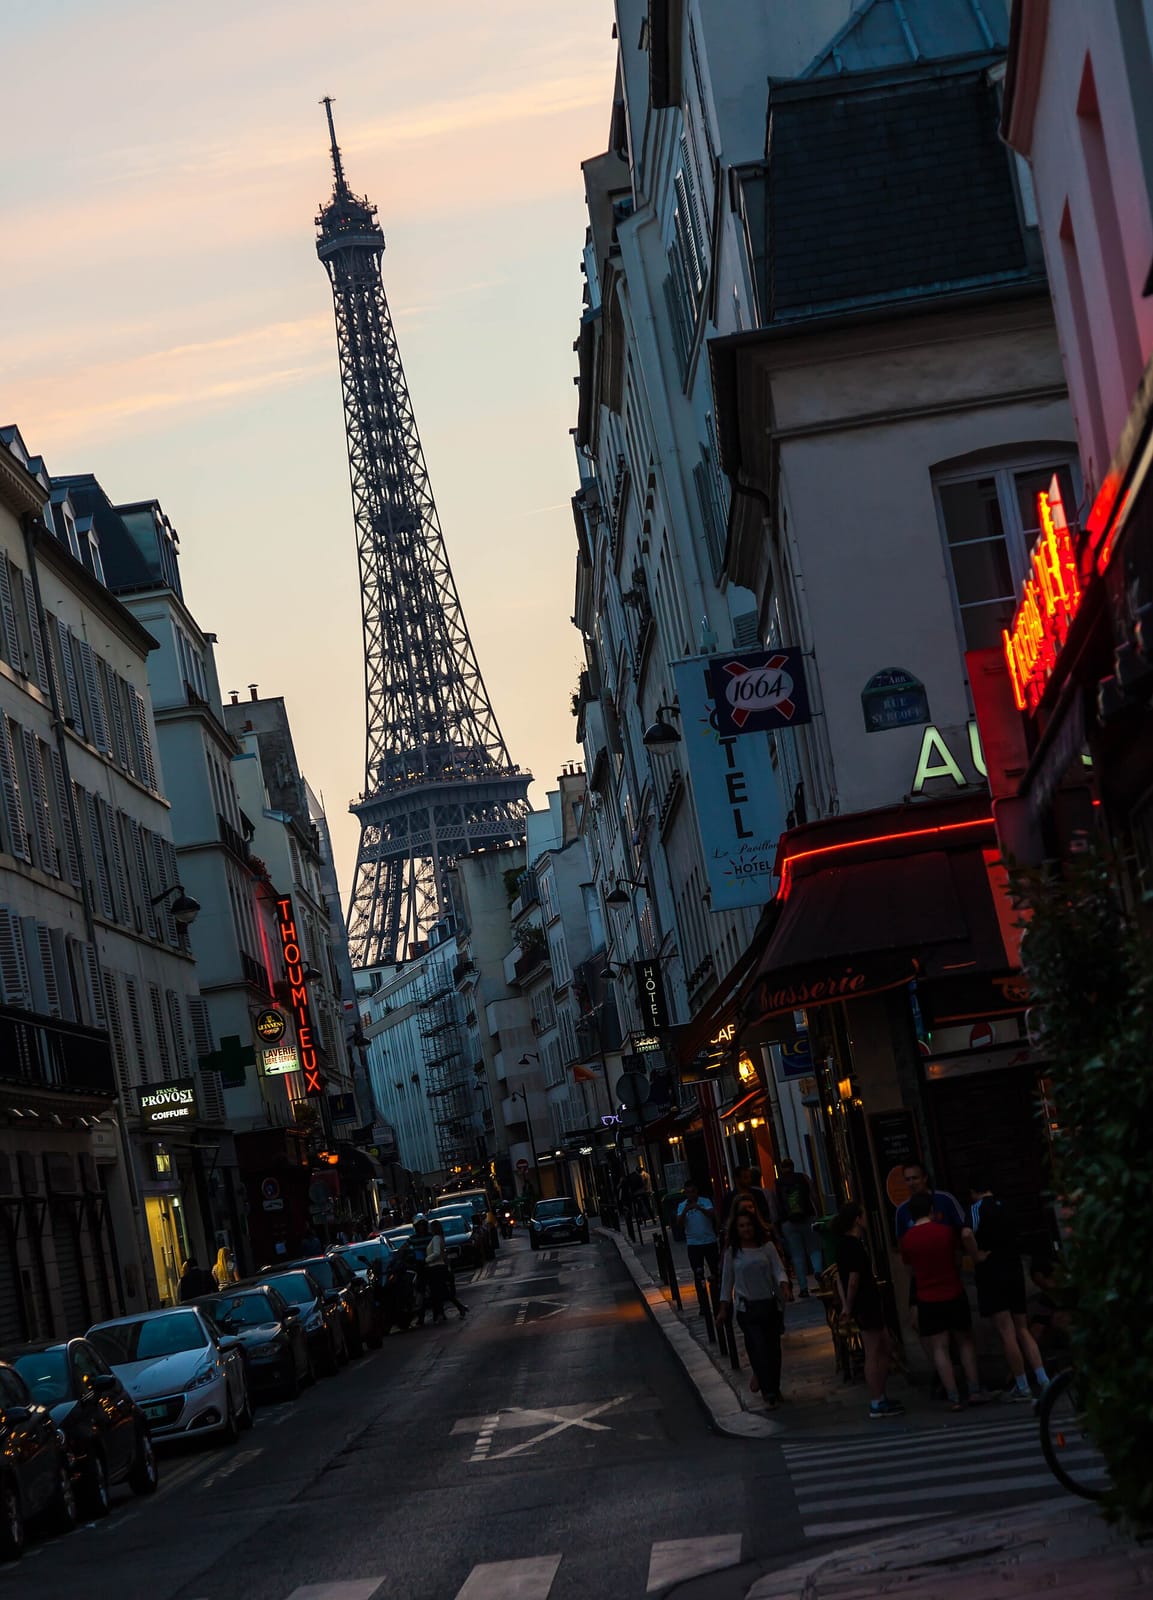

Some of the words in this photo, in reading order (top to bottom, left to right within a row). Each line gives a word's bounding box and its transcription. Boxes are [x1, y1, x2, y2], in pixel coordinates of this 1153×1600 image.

[733, 671, 787, 702] 1664
[734, 860, 772, 875] HOTEL
[276, 899, 321, 1092] THOUMIEUX
[263, 1046, 297, 1059] LAVERIE
[141, 1089, 193, 1108] PROVOST
[151, 1107, 189, 1121] COIFFURE
